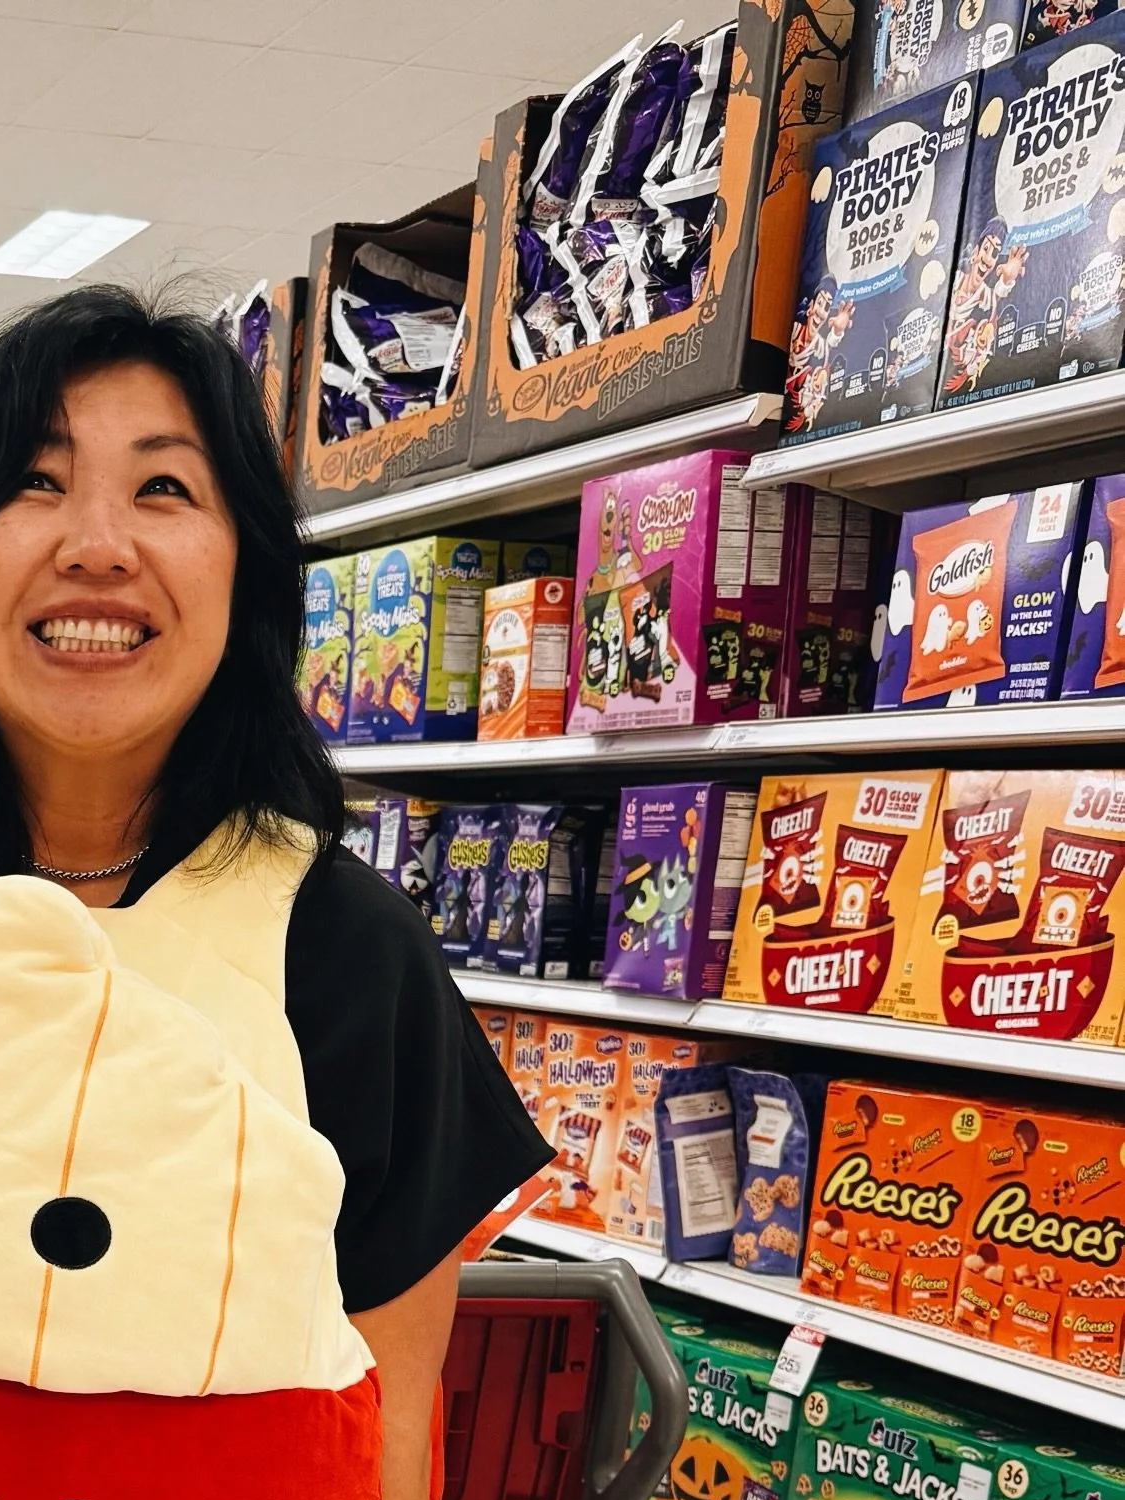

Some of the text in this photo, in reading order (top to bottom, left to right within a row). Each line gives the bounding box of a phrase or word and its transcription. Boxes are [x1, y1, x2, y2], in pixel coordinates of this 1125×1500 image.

[992, 30, 1008, 55] 18
[951, 88, 967, 111] 18
[1009, 56, 1125, 135] PIRATE'S
[1013, 98, 1114, 166] BOOTY
[941, 137, 965, 152] PUFFS
[837, 133, 938, 201] PIRATE'S
[1019, 146, 1091, 190] BOOS &
[841, 171, 923, 229] BOOTY
[847, 213, 905, 250] BOOS &
[1049, 307, 1062, 320] NO
[1021, 331, 1037, 343] REAL
[872, 356, 884, 370] NO
[546, 357, 610, 417] Veggie
[1039, 494, 1062, 515] 24
[642, 532, 662, 555] 30
[436, 565, 468, 582] Spooky
[929, 541, 993, 594] Goldfish
[377, 583, 404, 600] TREATS
[1013, 591, 1055, 609] GLOW
[361, 608, 392, 632] Spooky
[1011, 609, 1052, 620] IN THE DARK
[747, 623, 765, 637] 30
[939, 656, 968, 671] cheddar
[696, 790, 706, 803] 40
[860, 786, 922, 817] 30 GLOW
[1074, 785, 1112, 820] 30
[516, 1021, 530, 1039] 30
[995, 1017, 1040, 1030] ORIGINAL
[549, 1033, 568, 1053] 30
[629, 1042, 642, 1056] 30
[549, 1058, 616, 1087] HALLOWEEN
[575, 1093, 595, 1101] TRICK
[580, 1101, 600, 1109] TREAT
[960, 1113, 974, 1127] 18
[988, 1148, 1014, 1162] Reese's
[1077, 1158, 1108, 1183] Reese's
[821, 1154, 961, 1227] Reese's
[974, 1184, 1125, 1264] Reese's
[809, 1250, 836, 1273] Reese's
[856, 1263, 890, 1281] Reese's
[911, 1274, 948, 1290] Reese's
[960, 1285, 992, 1312] Reese's
[1013, 1300, 1050, 1322] Reese's
[1073, 1316, 1115, 1334] Reese's
[808, 1395, 823, 1415] 36
[701, 1391, 714, 1419] &
[716, 1396, 779, 1447] JACKS
[816, 1439, 871, 1479] BATS
[873, 1455, 890, 1486] &
[1003, 1464, 1023, 1485] 36
